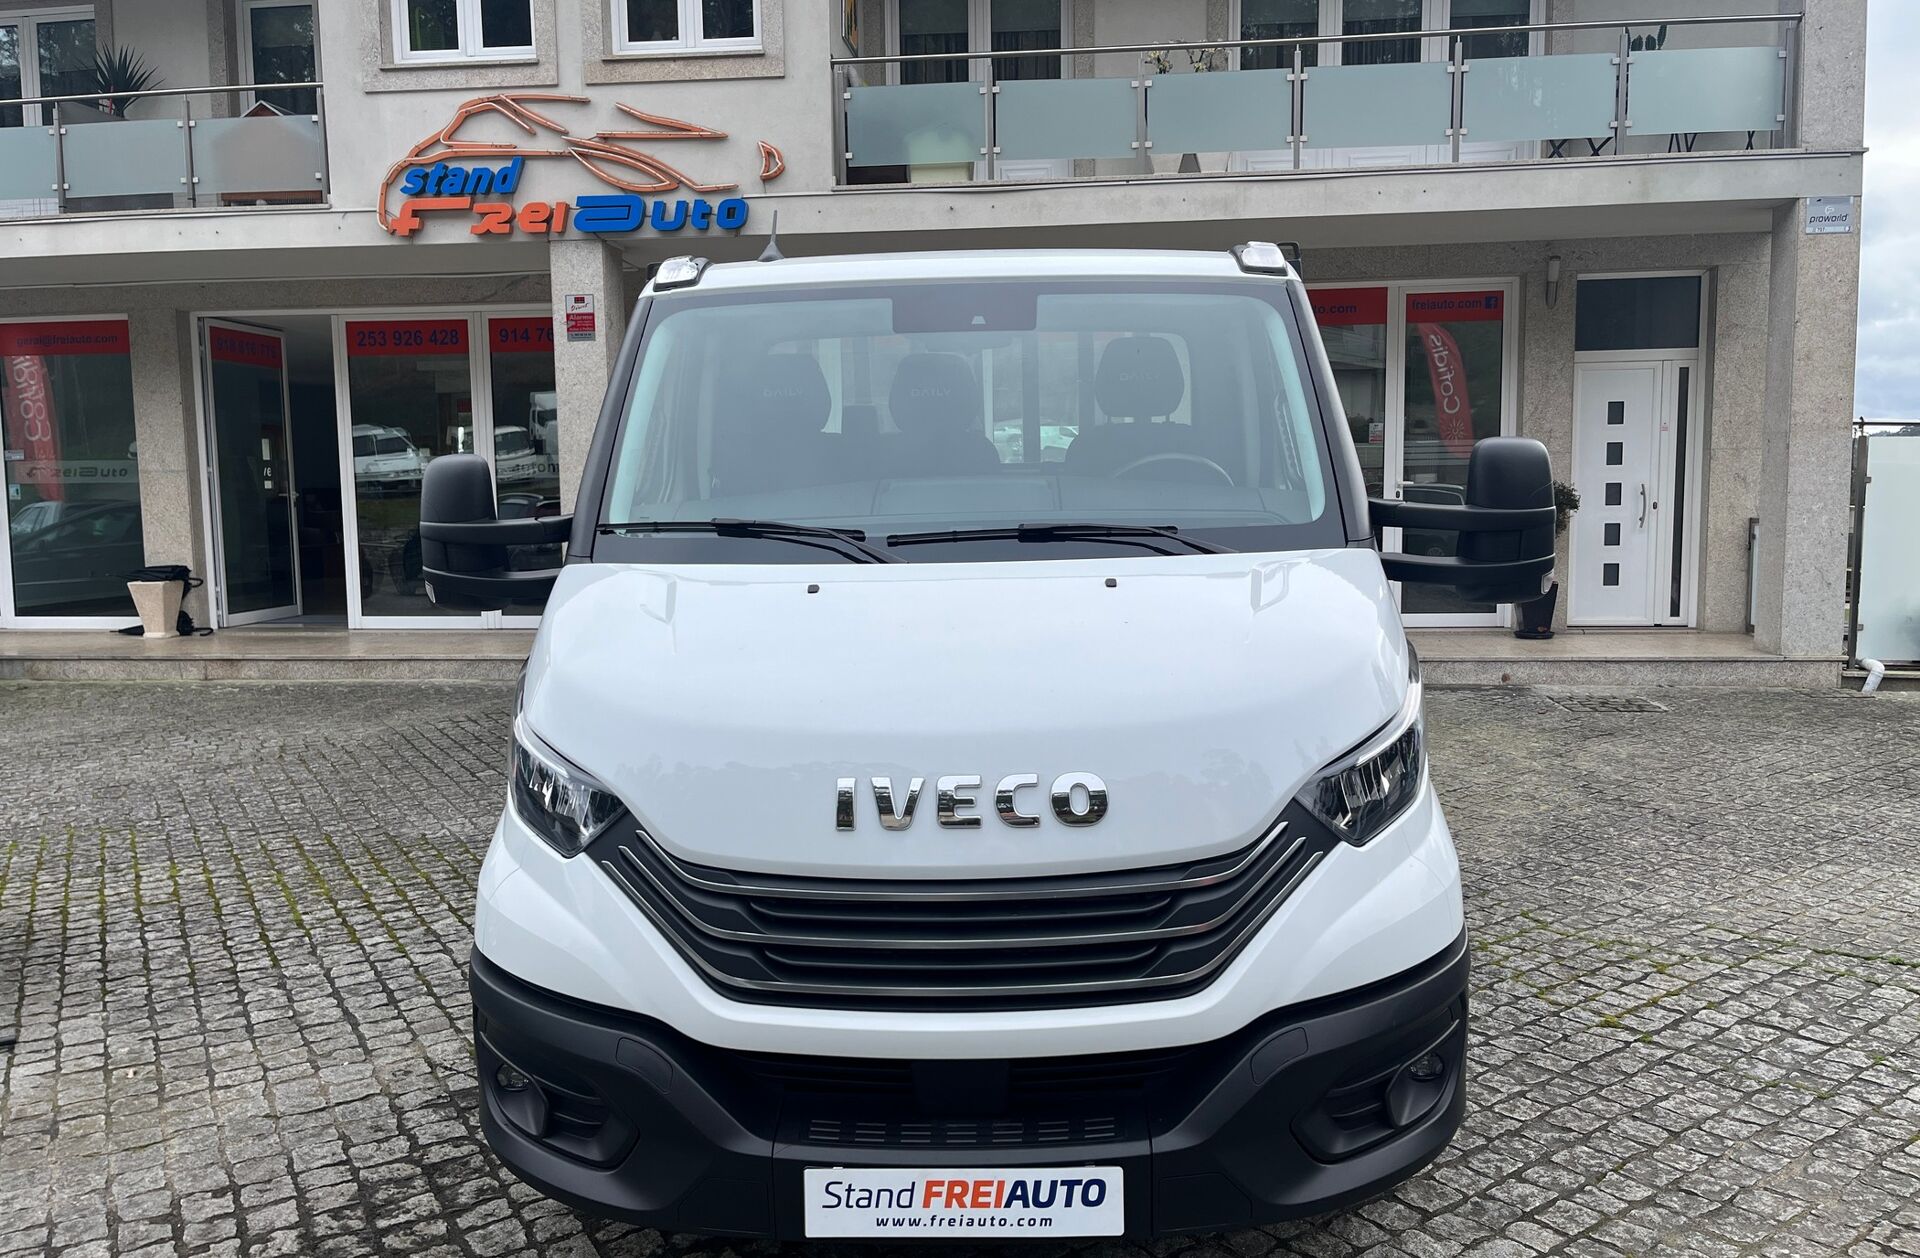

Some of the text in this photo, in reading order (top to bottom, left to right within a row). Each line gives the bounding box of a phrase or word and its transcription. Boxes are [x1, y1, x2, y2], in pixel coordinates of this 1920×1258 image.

[400, 157, 525, 196] stand
[1809, 213, 1849, 224] proworld
[1412, 298, 1482, 310] freiauto.com
[357, 329, 459, 347] 253 926 428
[500, 328, 530, 343] 914
[836, 772, 1108, 831] IVECO
[822, 1178, 1107, 1209] Stand FREIAUTO
[876, 1214, 1053, 1228] www.freiauto.com
